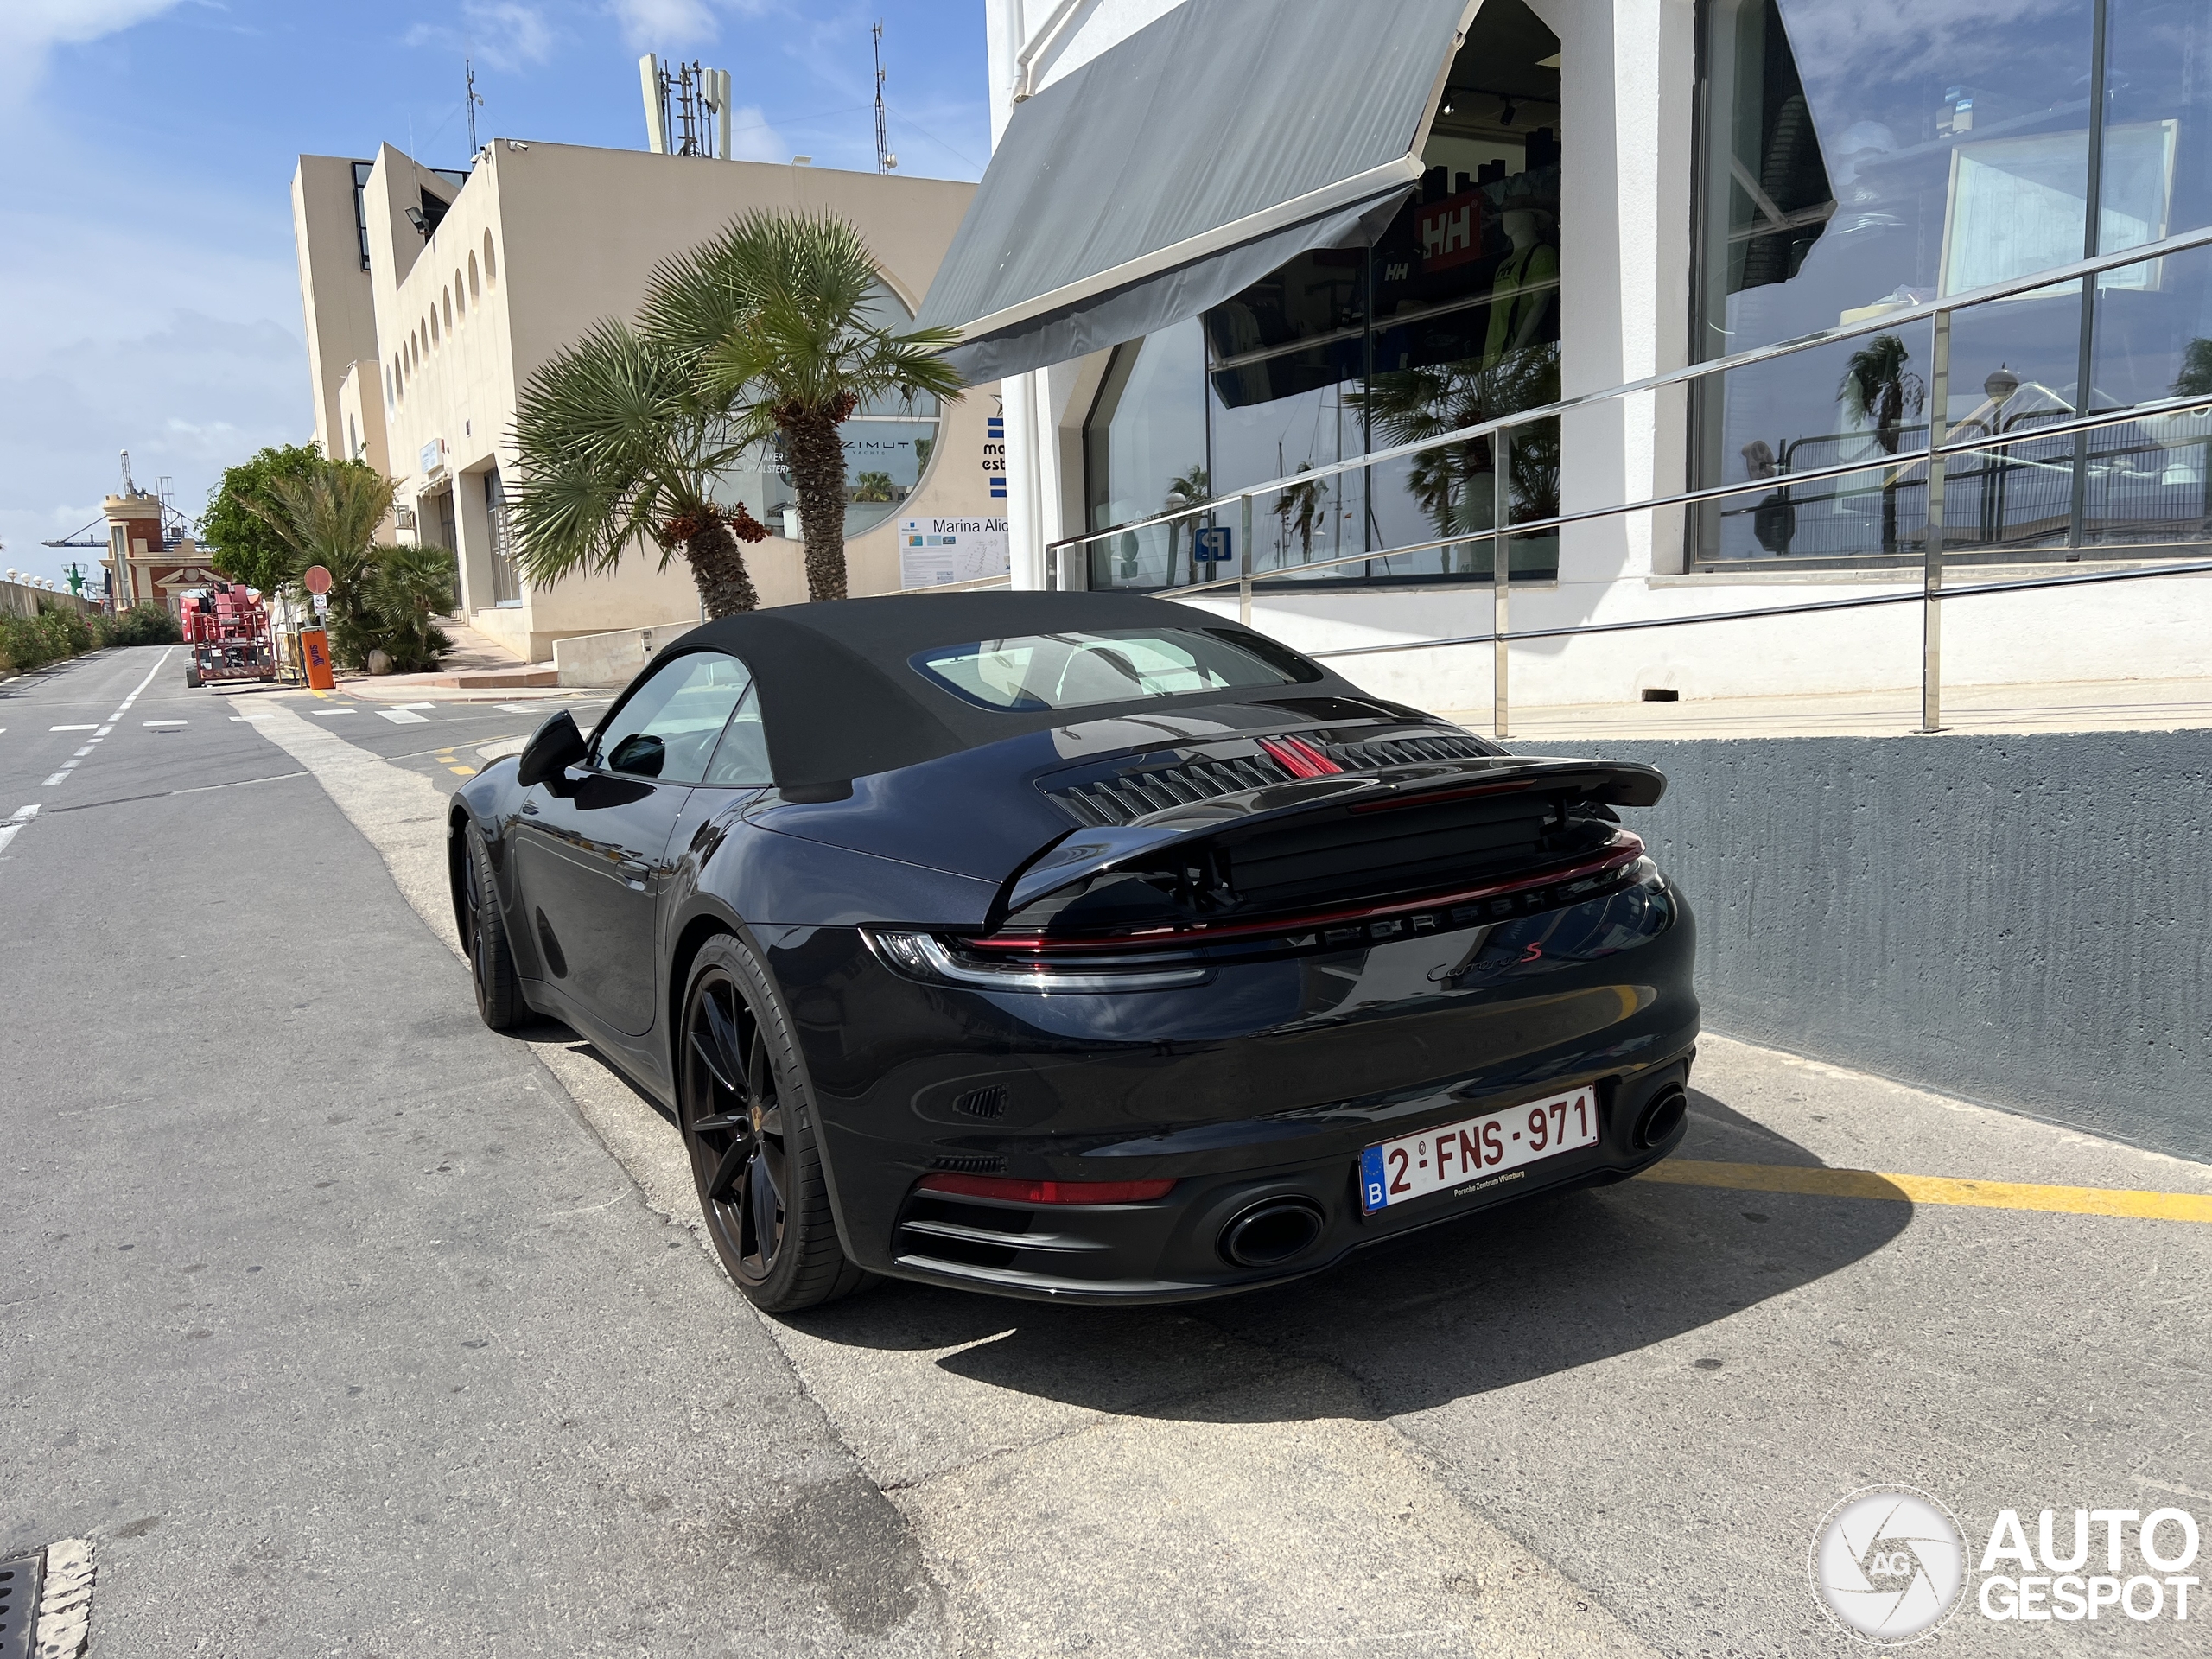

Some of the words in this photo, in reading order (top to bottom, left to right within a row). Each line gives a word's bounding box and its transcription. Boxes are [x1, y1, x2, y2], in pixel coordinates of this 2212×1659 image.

[1422, 205, 1471, 259] HH
[1384, 262, 1408, 282] HH
[742, 463, 790, 475] UPHOLSTERY
[933, 519, 980, 533] Marina
[984, 518, 1009, 532] Alic
[1368, 1181, 1382, 1205] B
[1453, 1185, 1476, 1197] Porsche
[1475, 1178, 1499, 1191] Zentrum
[1498, 1170, 1525, 1184] Würzburg
